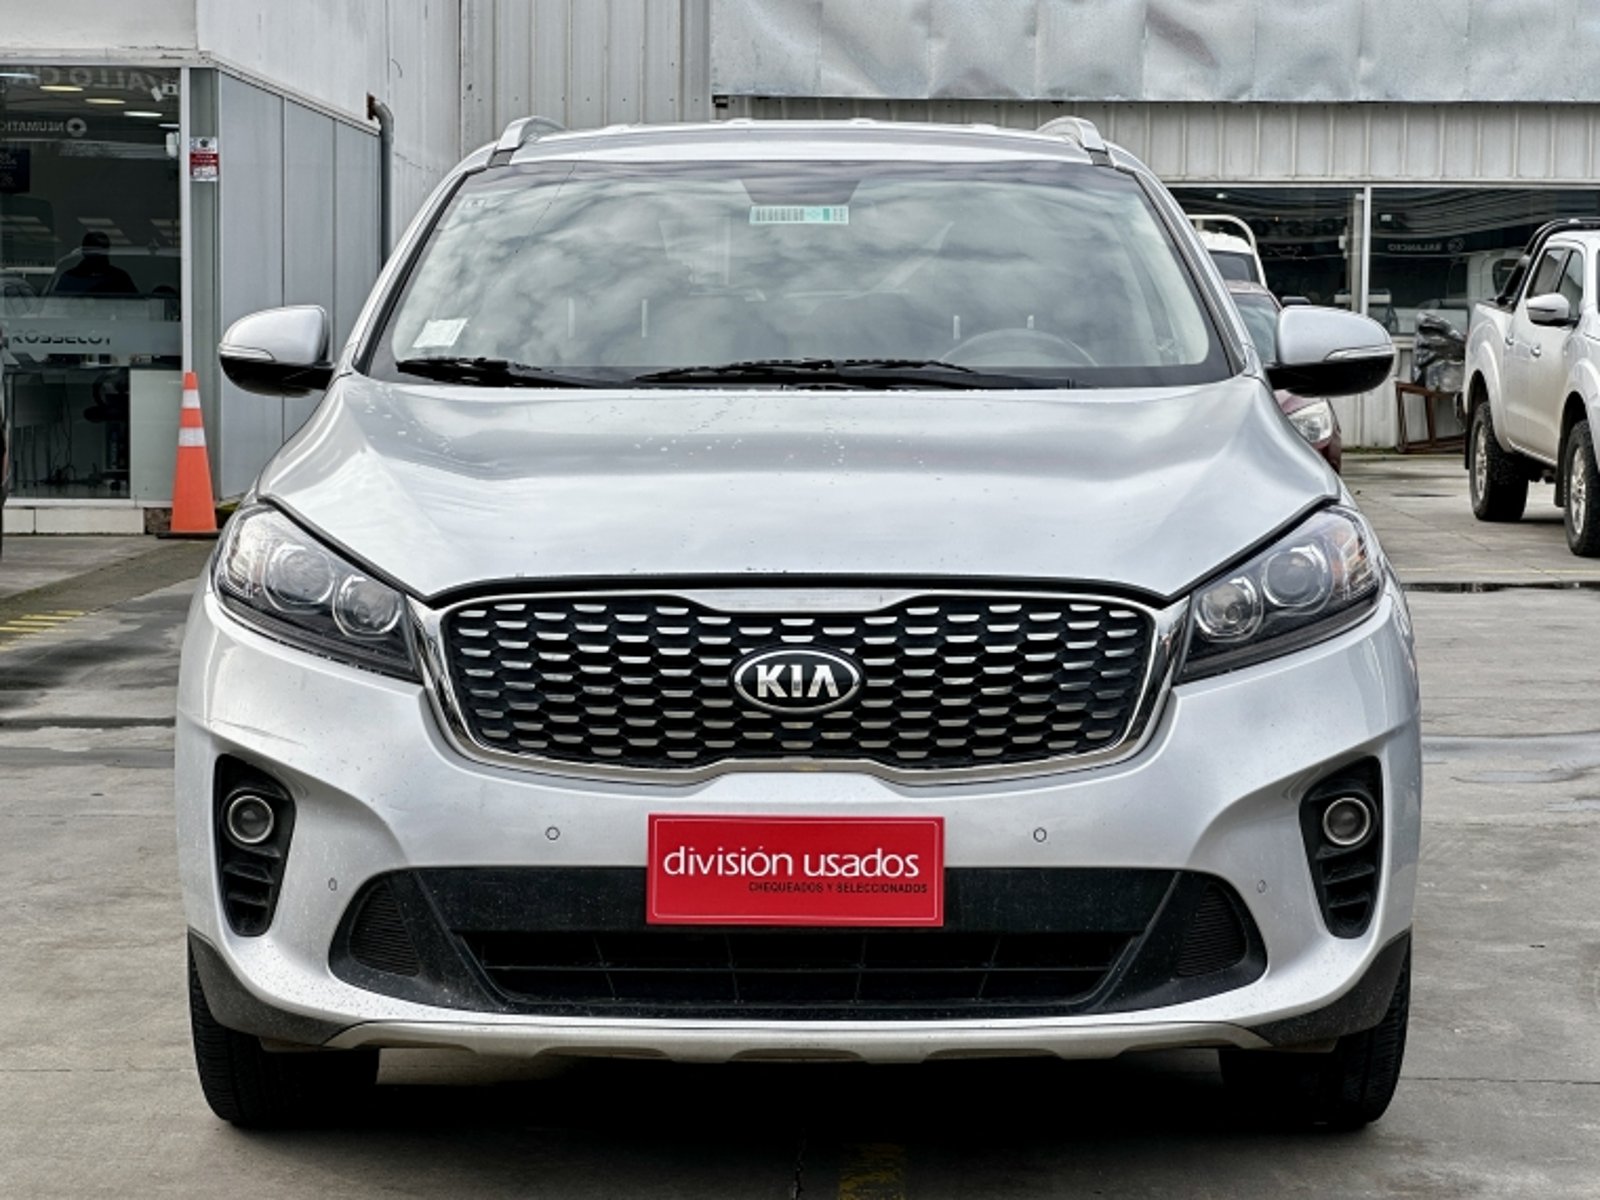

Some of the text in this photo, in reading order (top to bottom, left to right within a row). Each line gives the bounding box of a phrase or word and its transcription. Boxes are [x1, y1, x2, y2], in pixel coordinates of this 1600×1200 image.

[755, 664, 840, 698] KIA
[663, 846, 920, 878] división usados
[748, 881, 928, 894] CHEQUEADOS Y SELECCIONADOS
